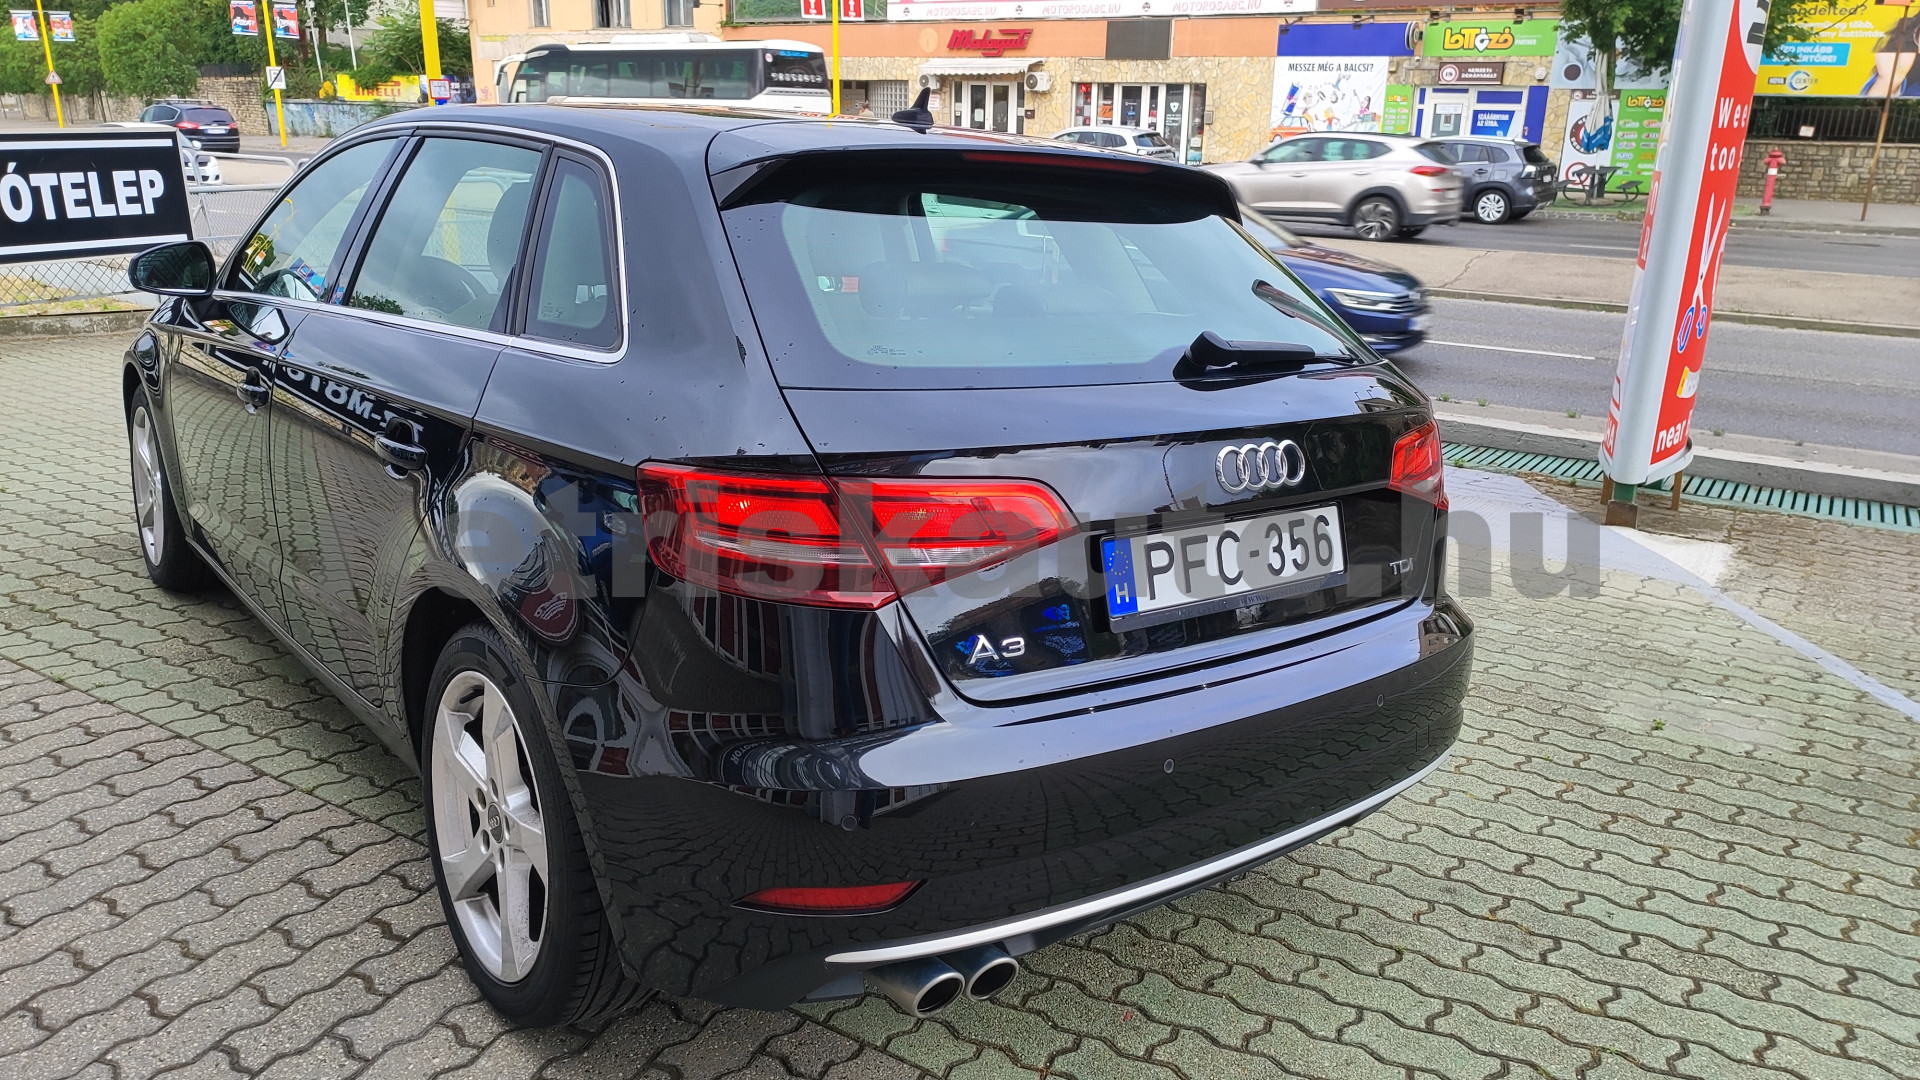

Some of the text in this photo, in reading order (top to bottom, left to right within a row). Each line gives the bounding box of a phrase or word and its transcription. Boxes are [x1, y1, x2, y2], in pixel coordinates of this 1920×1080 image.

[1288, 61, 1374, 72] MESSZE MÉG A BALCSI?
[0, 162, 165, 223] ÓTELEP
[1656, 419, 1687, 453] near
[1143, 514, 1334, 600] PFC-356
[1389, 557, 1415, 575] TDI
[1113, 582, 1130, 605] H
[968, 633, 1026, 667] A3
